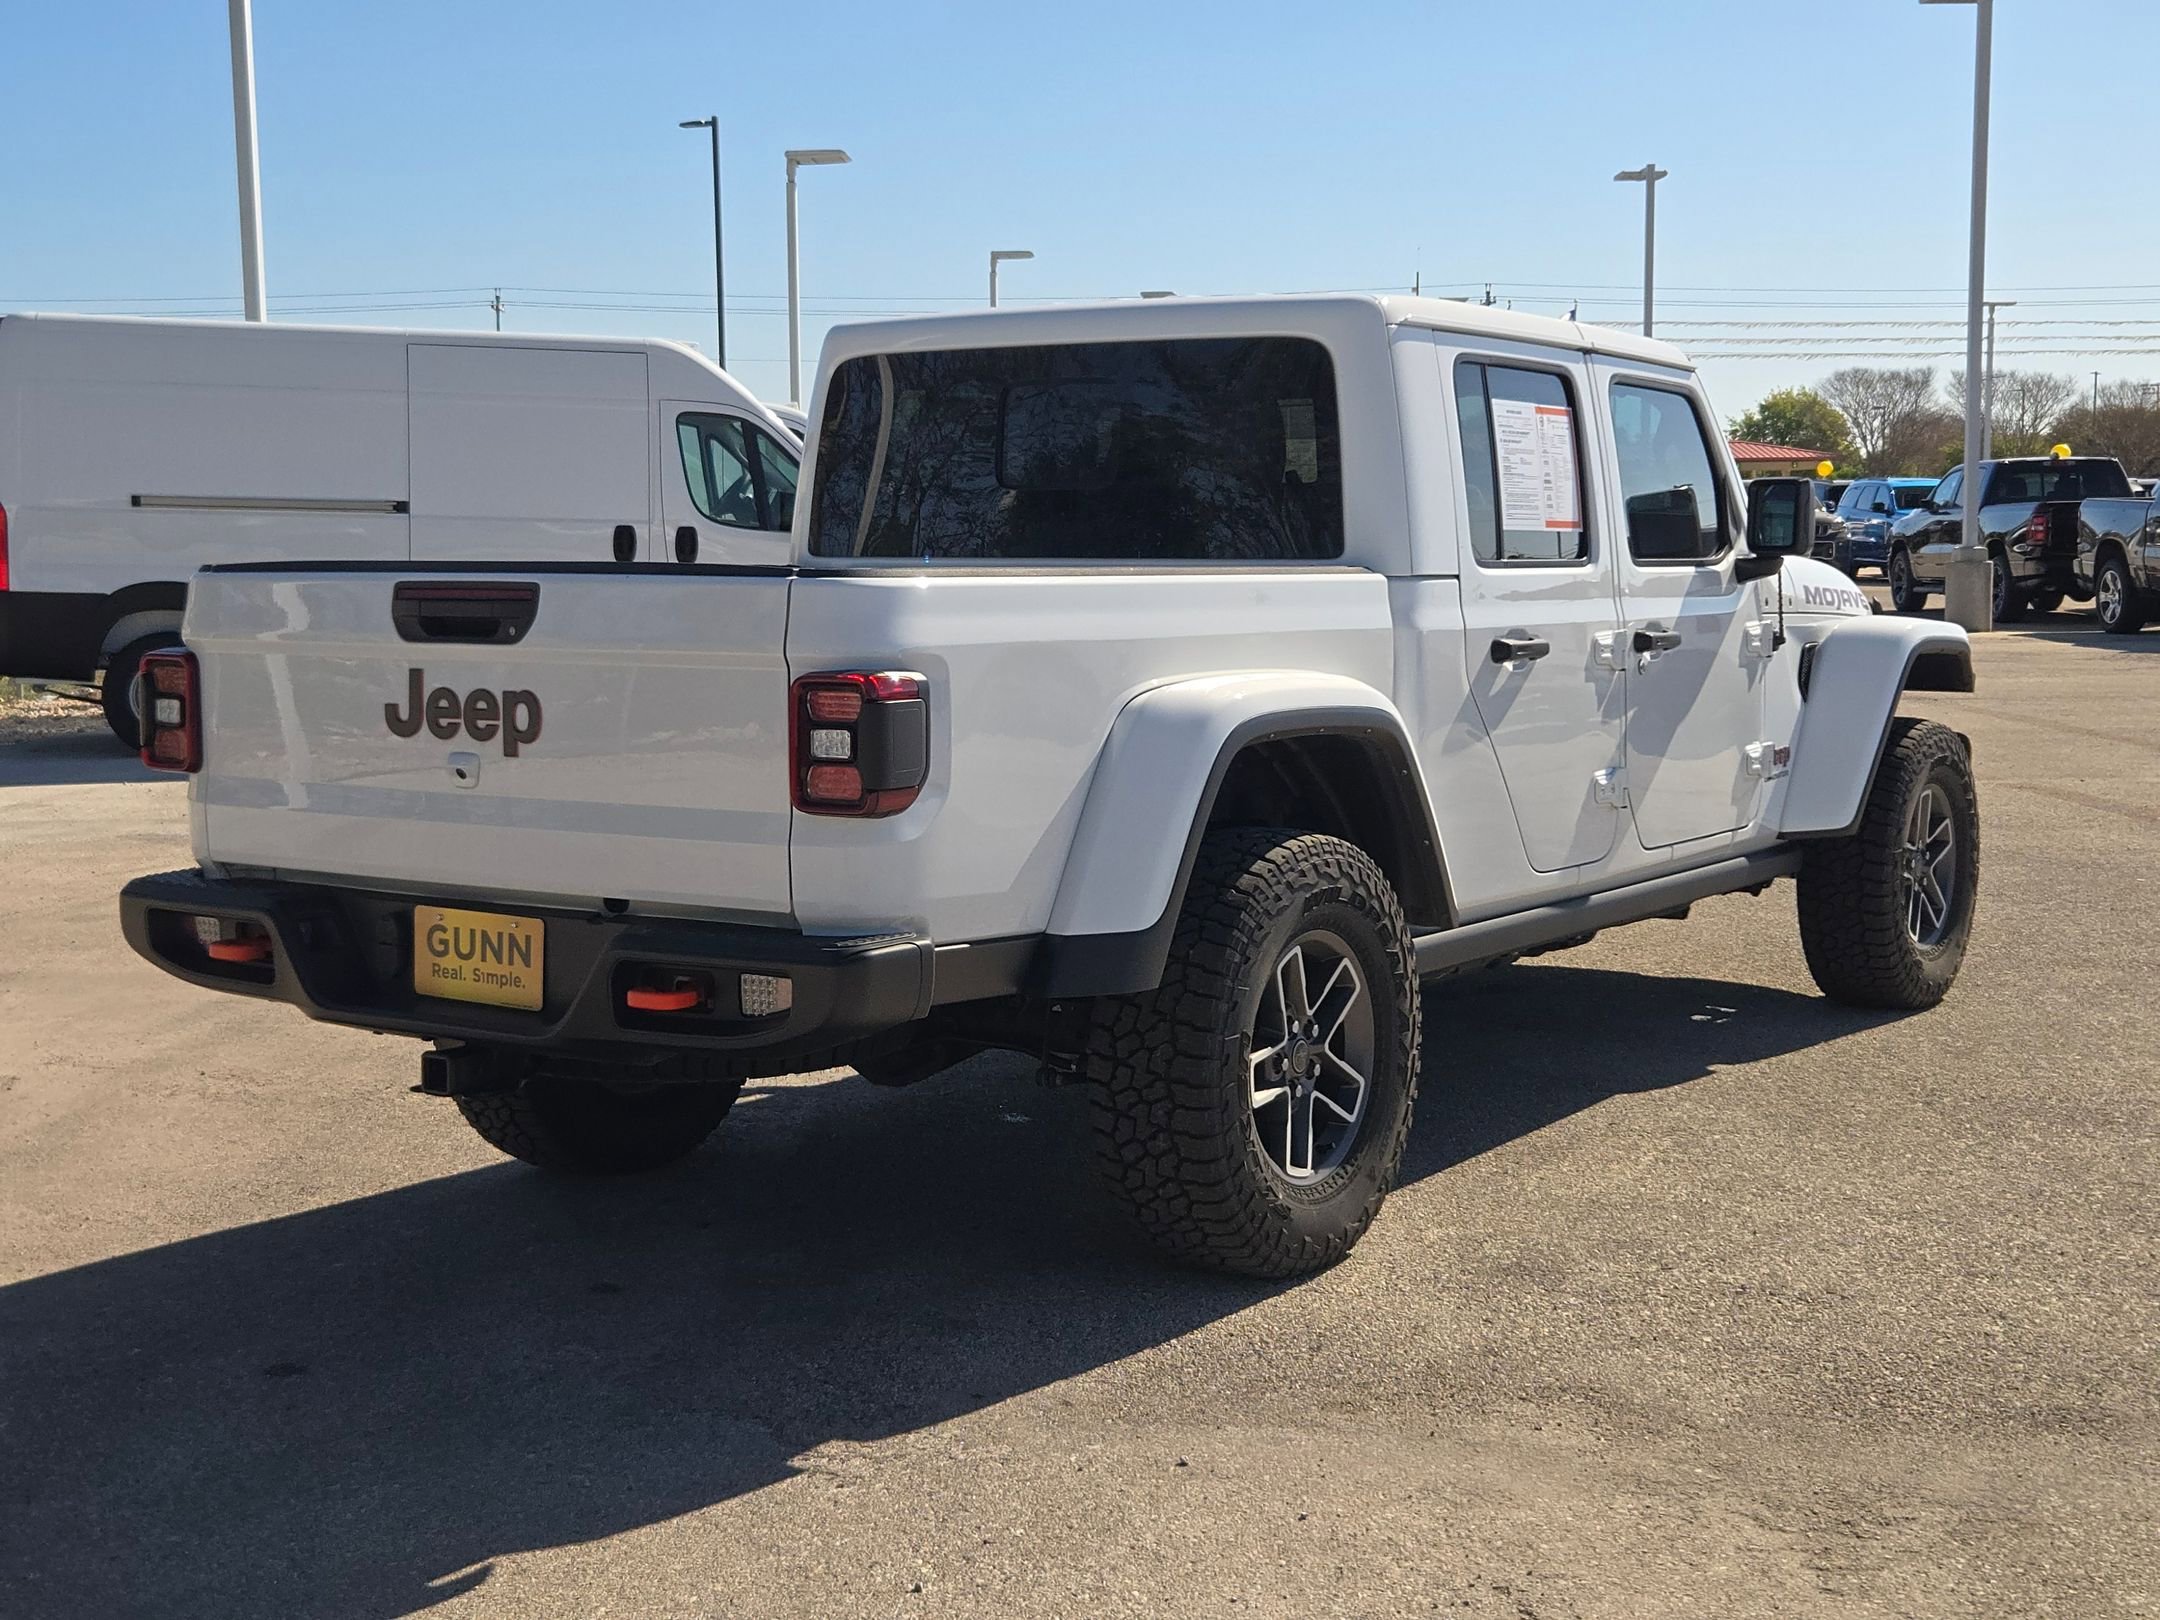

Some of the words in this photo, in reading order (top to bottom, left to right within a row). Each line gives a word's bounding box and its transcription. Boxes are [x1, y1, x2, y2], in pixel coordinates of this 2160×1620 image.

[1803, 585, 1869, 610] MOJAVE
[384, 668, 542, 758] Jeep
[427, 923, 532, 968] GUNN
[431, 962, 467, 981] Real.
[472, 967, 526, 989] Simple.
